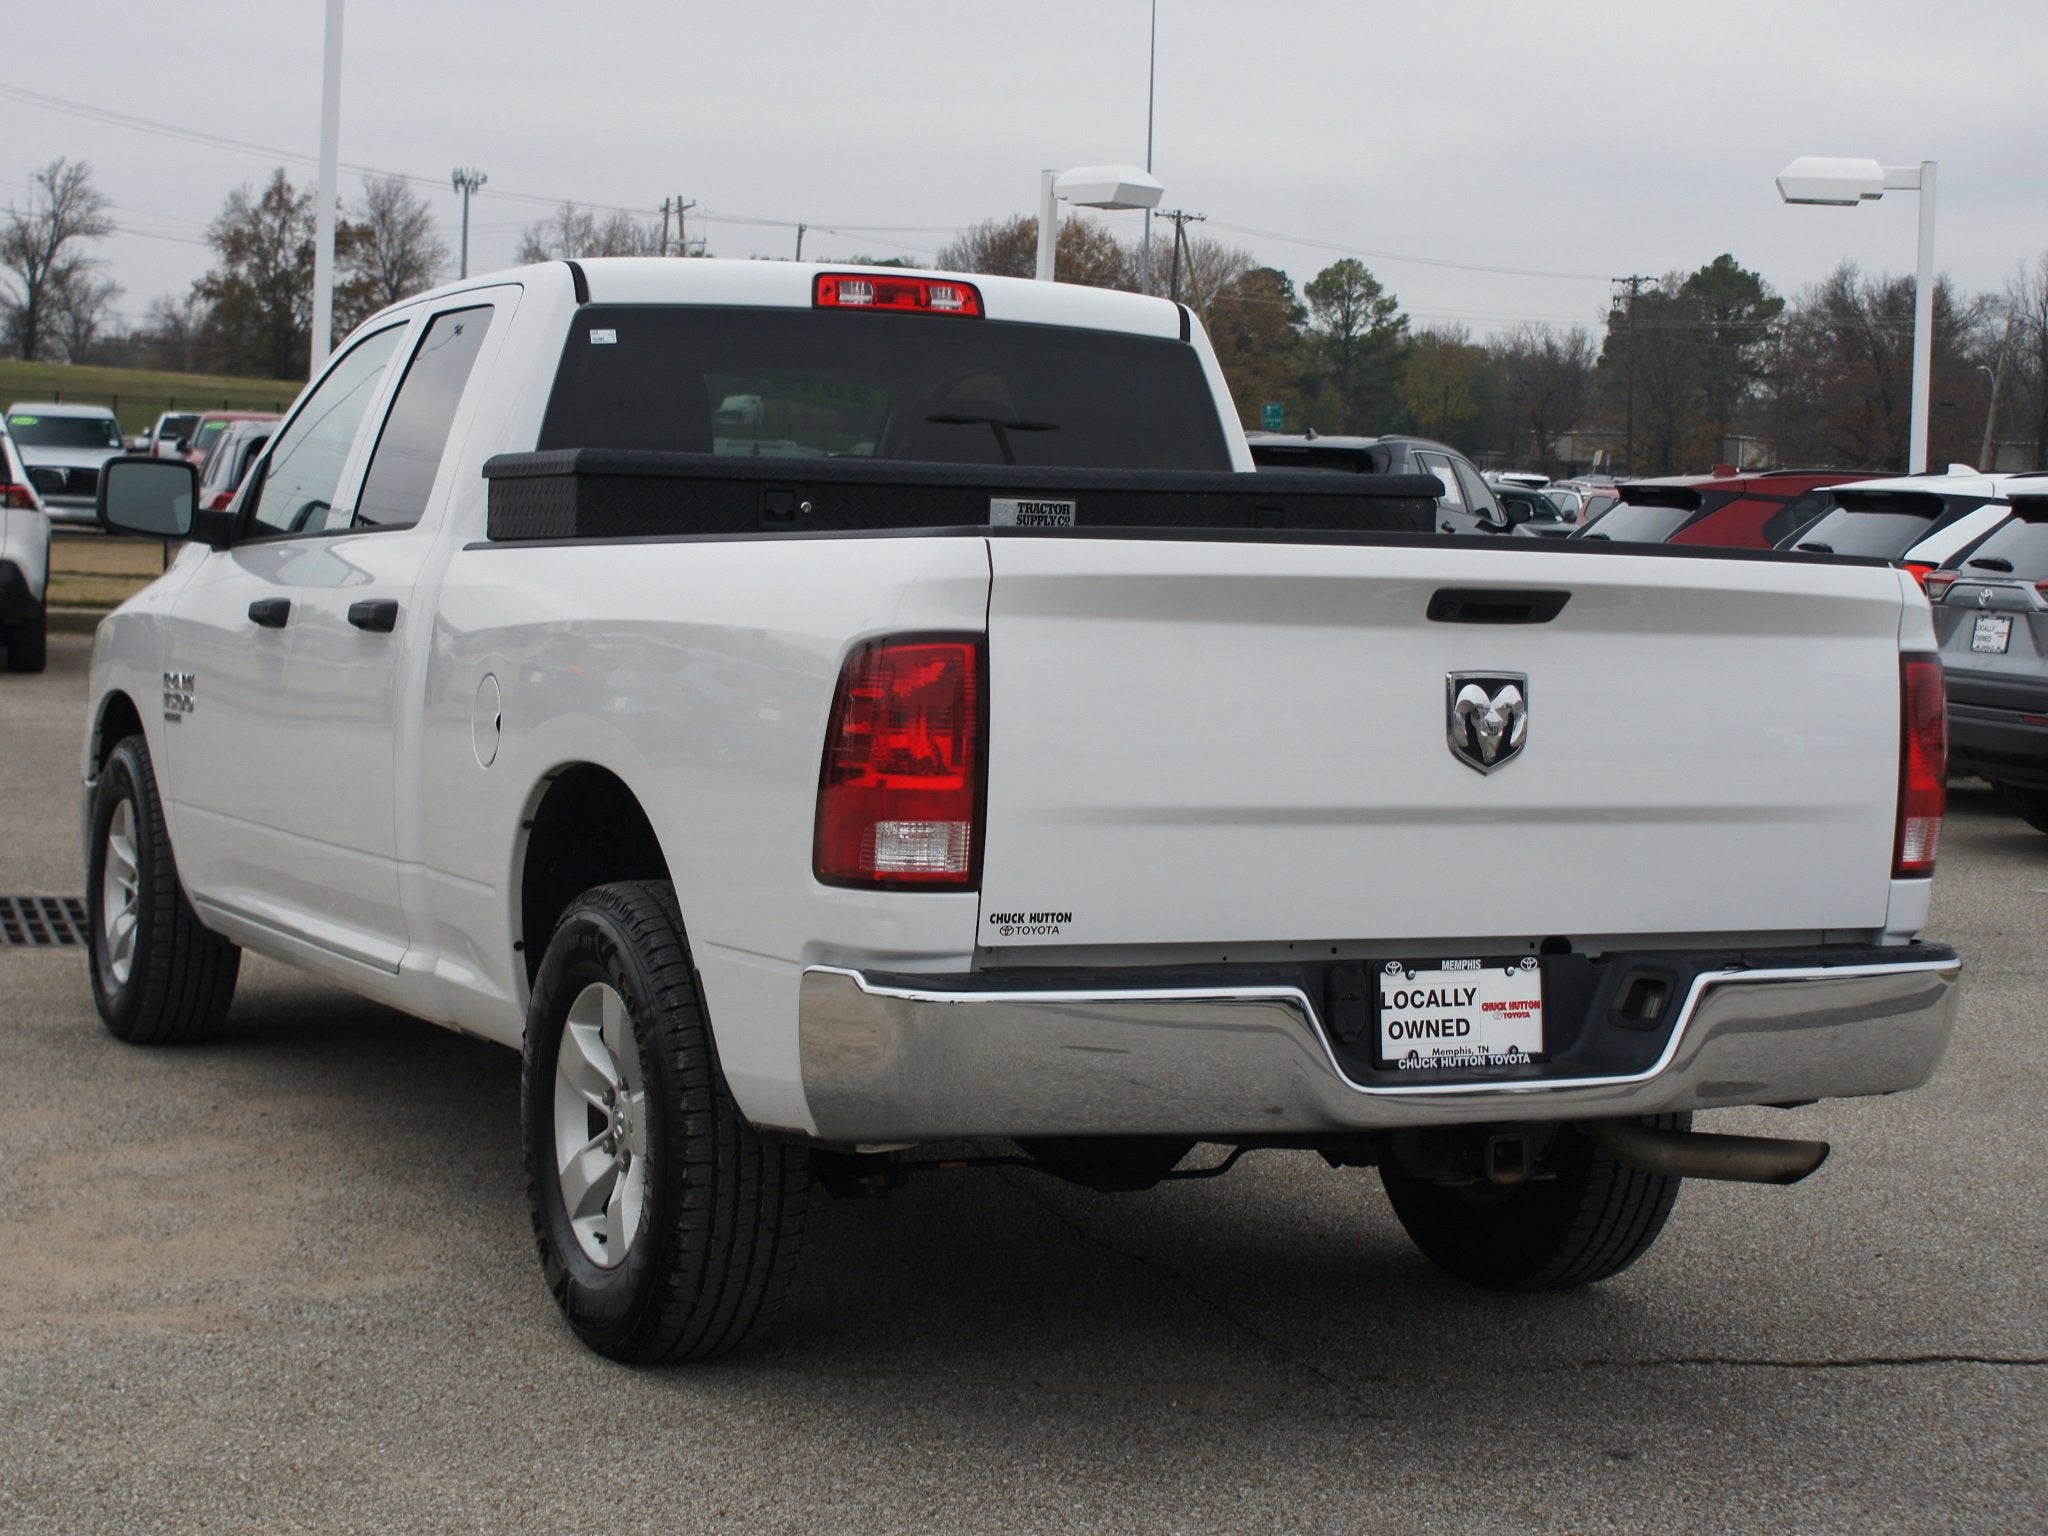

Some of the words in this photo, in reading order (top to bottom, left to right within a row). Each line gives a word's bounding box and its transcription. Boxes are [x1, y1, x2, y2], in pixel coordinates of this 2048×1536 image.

[1016, 502, 1071, 515] TRACTOR
[1016, 514, 1057, 526] SUPPLY
[989, 913, 1025, 924] CHUCK
[1029, 912, 1072, 923] HUTTON
[1016, 925, 1060, 935] TOYOTA
[1441, 959, 1482, 971] MEMPHIS
[1380, 987, 1477, 1010] LOCALLY
[1481, 1001, 1507, 1011] CHUCK
[1509, 1000, 1541, 1010] HUTTON
[1503, 1011, 1531, 1019] TOYOTA
[1388, 1018, 1470, 1040] OWNED
[1432, 1045, 1474, 1057] Memphis,
[1477, 1045, 1489, 1054] TN
[1398, 1057, 1437, 1070] CHUCK
[1440, 1055, 1485, 1068] HUTTON
[1488, 1053, 1531, 1065] TOYOTA
